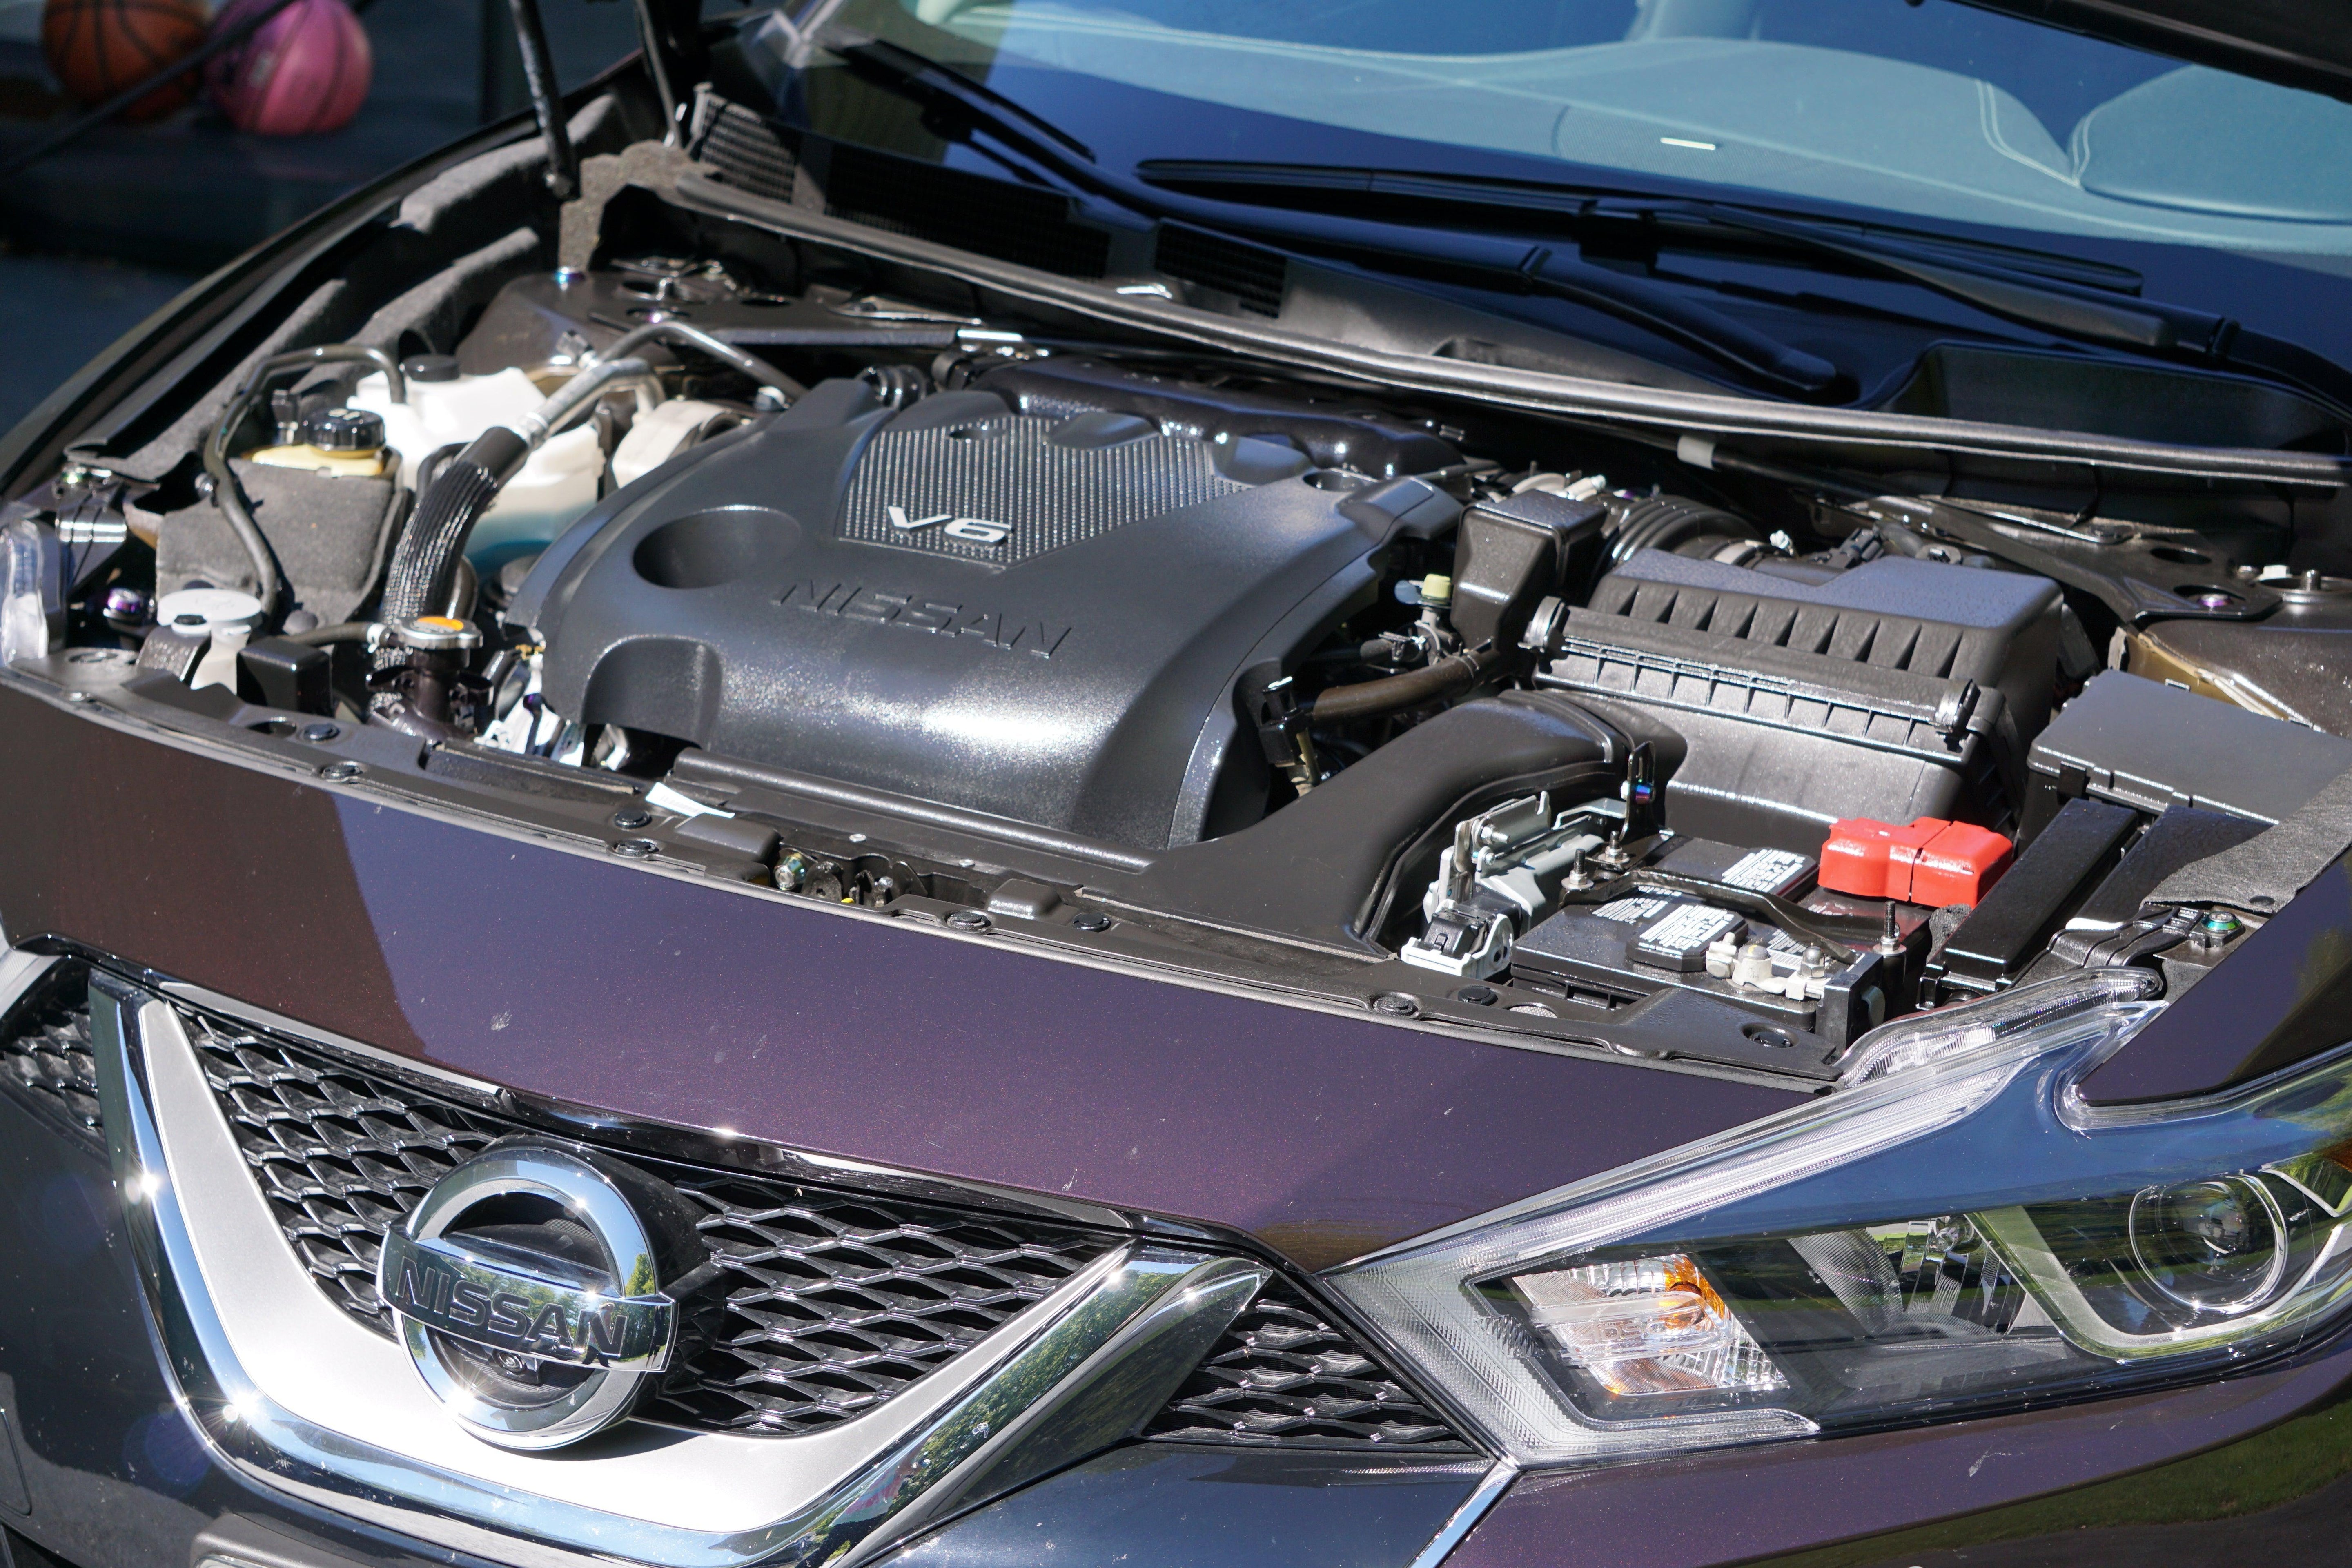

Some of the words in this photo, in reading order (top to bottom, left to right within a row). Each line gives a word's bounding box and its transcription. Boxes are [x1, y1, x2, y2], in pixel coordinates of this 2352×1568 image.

[887, 506, 1015, 544] V6
[770, 579, 1072, 659] NISSAN
[396, 1256, 628, 1356] NISSAN
